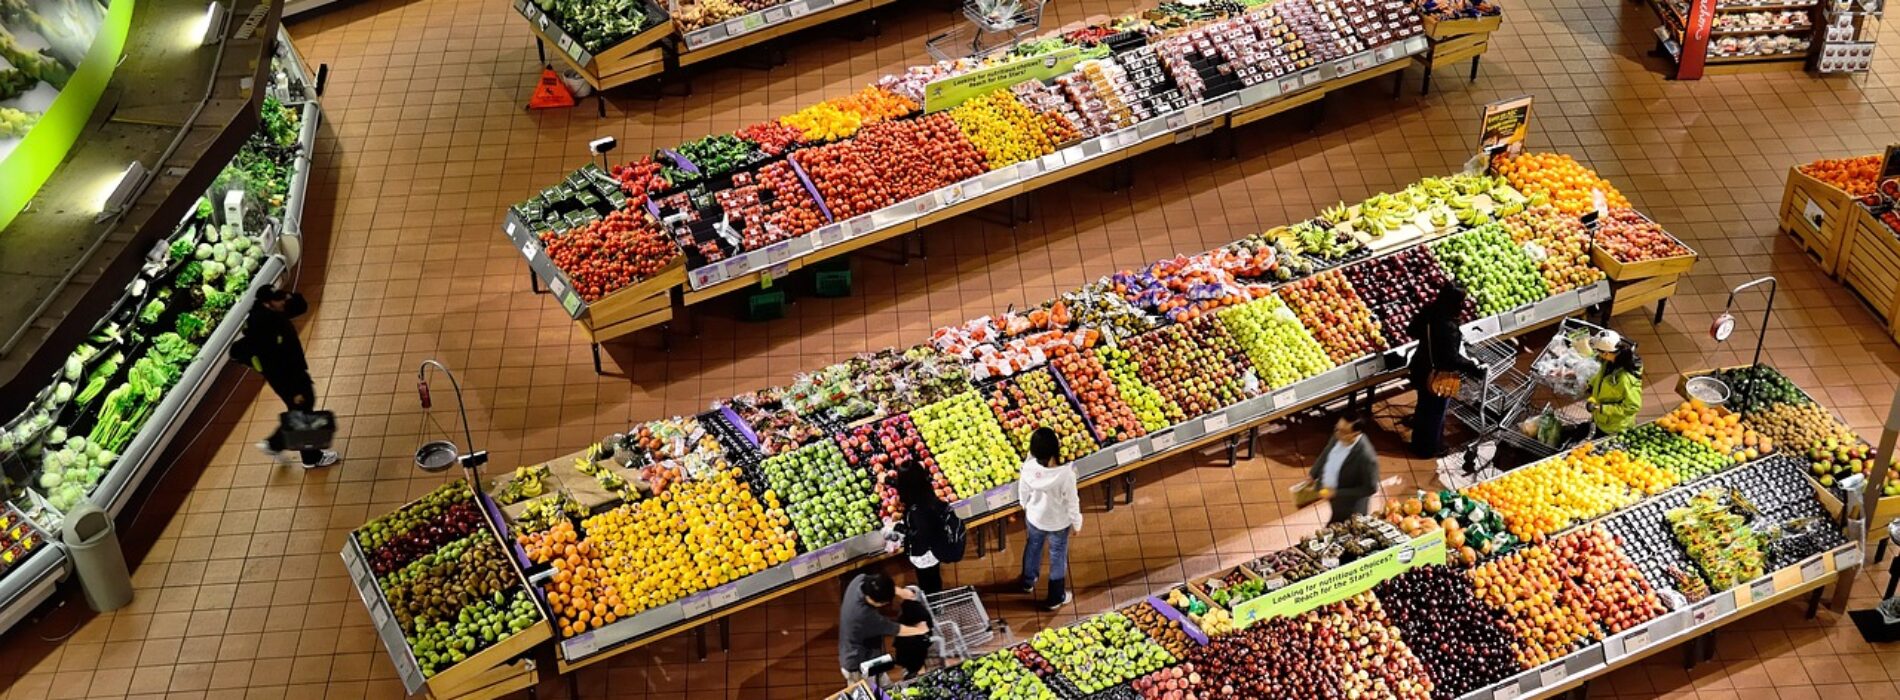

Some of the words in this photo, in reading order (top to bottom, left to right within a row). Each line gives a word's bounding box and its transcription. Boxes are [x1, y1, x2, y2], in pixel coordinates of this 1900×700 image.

[953, 77, 976, 86] Looking
[987, 66, 1016, 77] nutritious
[1016, 59, 1041, 70] choices?
[1009, 69, 1027, 78] Stars!
[1272, 588, 1304, 604] Looking
[1305, 583, 1317, 592] for
[1319, 570, 1358, 586] nutritious
[1359, 554, 1393, 574] choices?
[1294, 591, 1319, 604] Reach
[1320, 585, 1332, 594] for
[1334, 579, 1348, 589] the
[1350, 569, 1373, 584] Stars!
